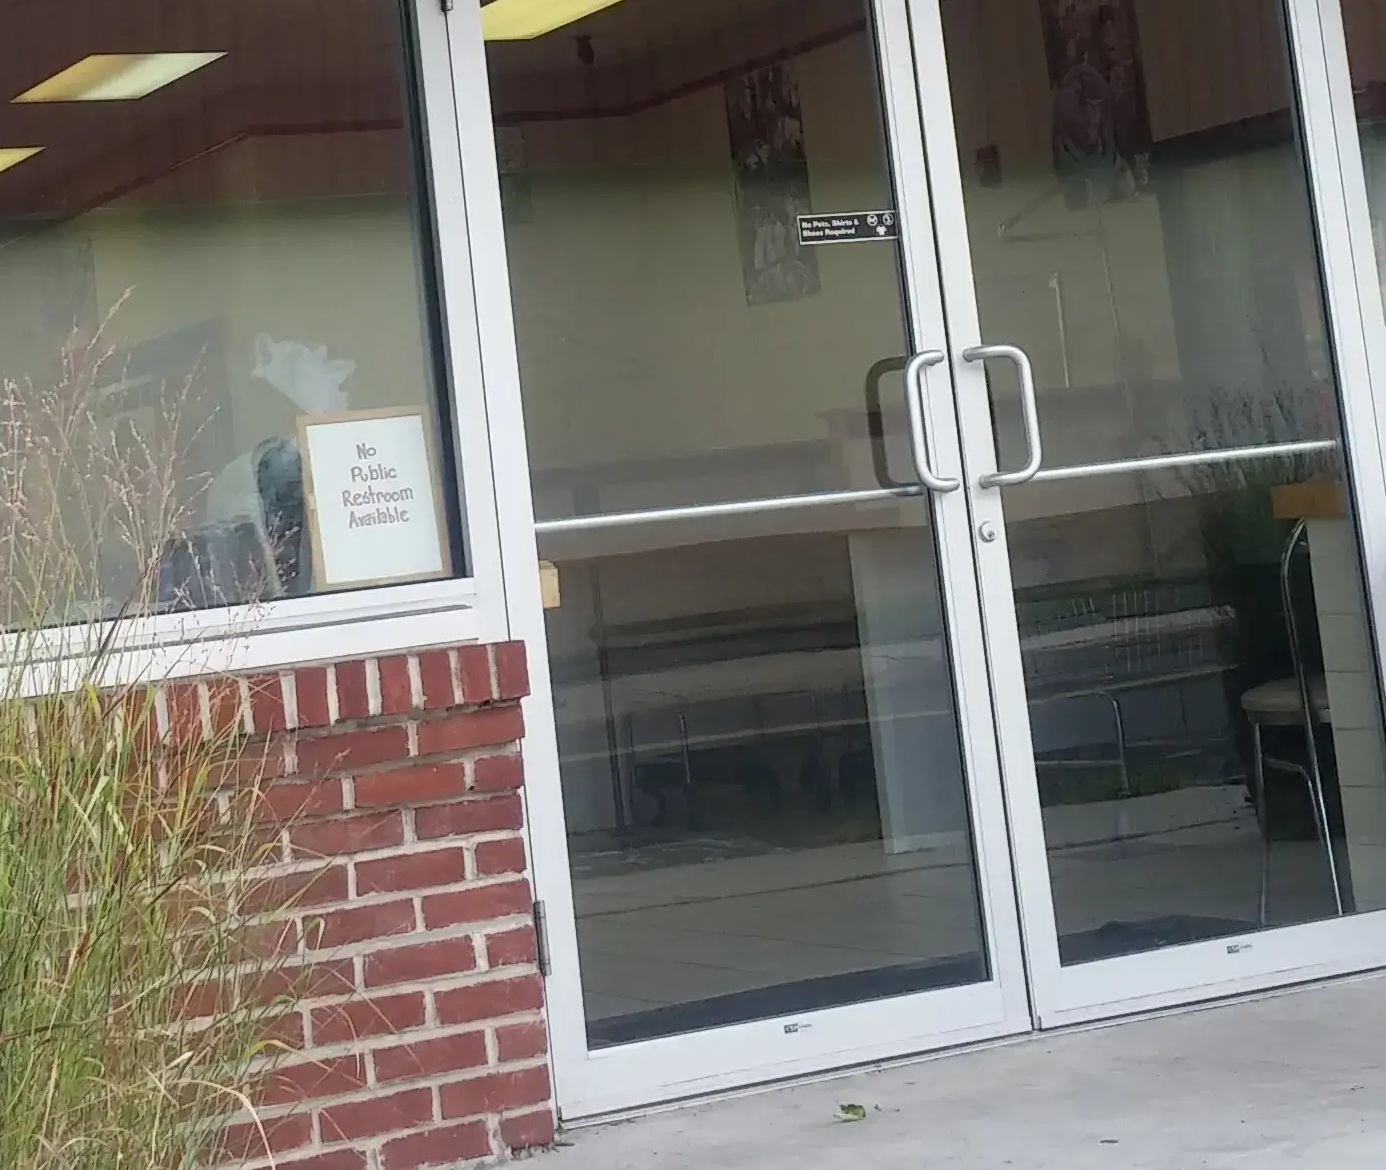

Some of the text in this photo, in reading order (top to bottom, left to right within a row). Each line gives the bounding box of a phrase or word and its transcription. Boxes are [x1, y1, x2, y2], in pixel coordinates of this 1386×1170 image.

[801, 221, 812, 229] No
[831, 218, 853, 227] Shirts
[802, 227, 856, 237] Shoes Required
[356, 443, 377, 460] No
[350, 463, 398, 483] Public
[341, 485, 414, 508] Restroom
[348, 506, 411, 529] Available
